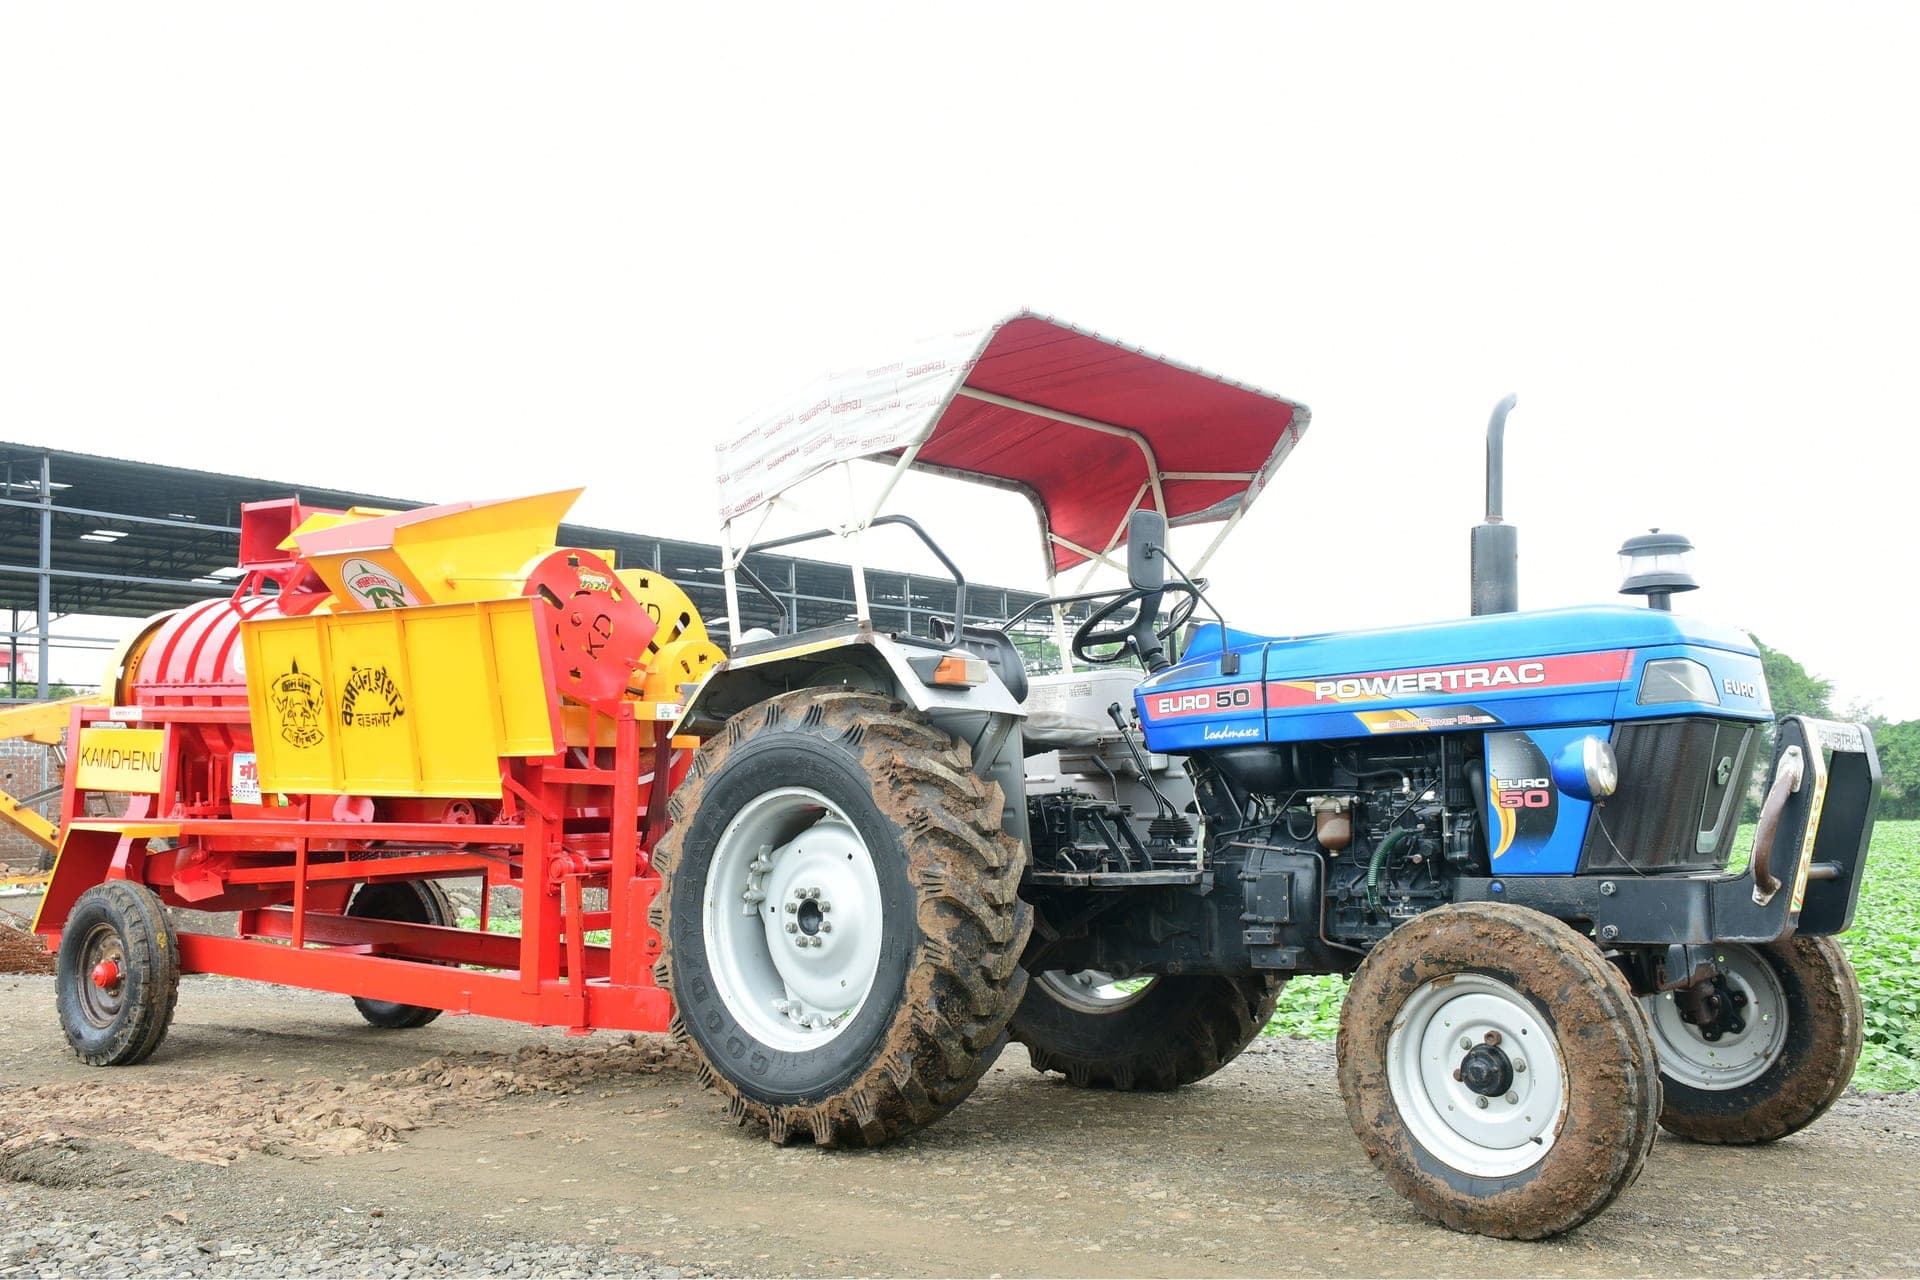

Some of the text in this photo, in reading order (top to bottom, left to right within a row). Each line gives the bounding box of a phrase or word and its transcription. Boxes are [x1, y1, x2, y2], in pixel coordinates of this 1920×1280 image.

[1314, 661, 1545, 700] POWERTRAC
[1723, 677, 1755, 698] EURO
[1158, 687, 1251, 713] EURO 50
[1423, 717, 1457, 727] Saver
[1457, 715, 1483, 724] Plus
[81, 747, 162, 773] KAMDHENU
[1497, 778, 1549, 789] EURO
[1499, 789, 1550, 808] 50
